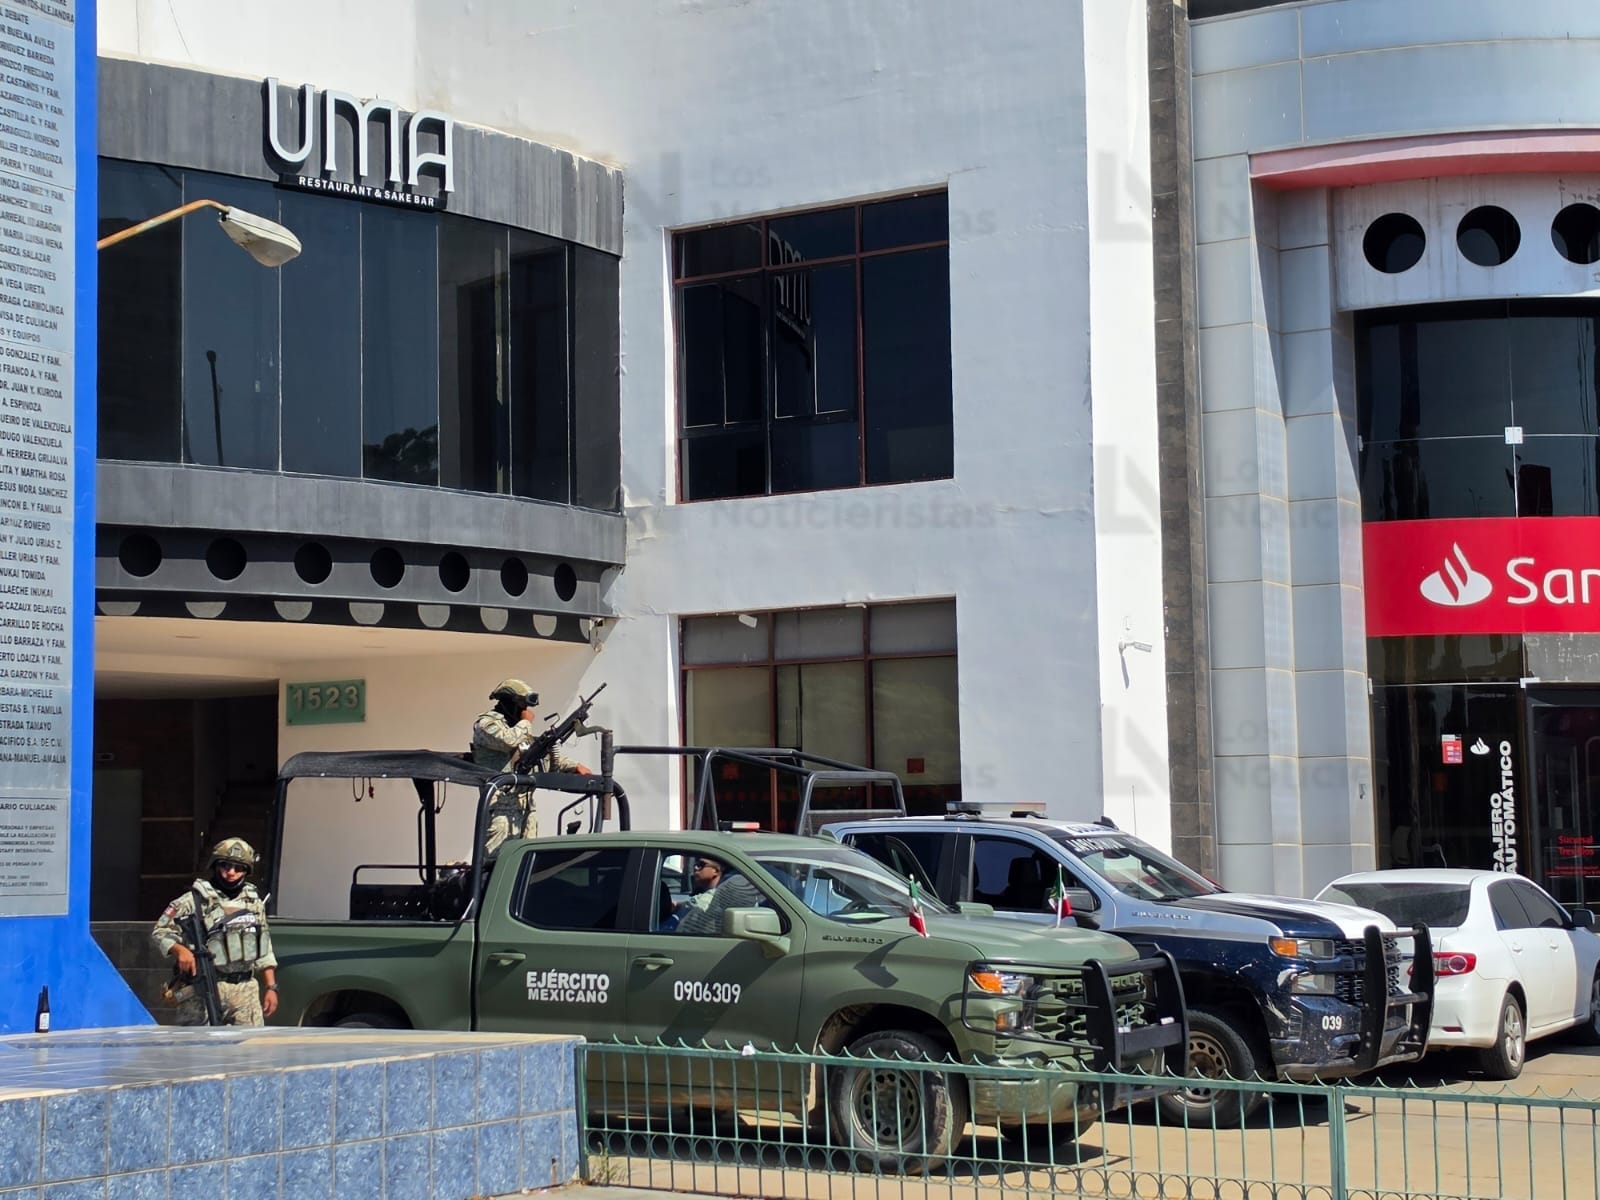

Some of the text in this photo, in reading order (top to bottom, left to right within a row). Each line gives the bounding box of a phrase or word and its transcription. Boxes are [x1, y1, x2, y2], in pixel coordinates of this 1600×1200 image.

[266, 77, 454, 192] UMA
[299, 177, 434, 207] RESTAURANT & SAKE BAR
[22, 433, 62, 448] VALENZUELA
[14, 635, 44, 647] BARRAZA
[295, 686, 358, 711] 1523
[1500, 741, 1517, 874] AUTOMÁTICO
[1491, 793, 1505, 872] CAJERO
[527, 969, 610, 990] EJÉRCITO
[528, 989, 607, 1003] MEXICANO
[674, 981, 741, 1004] 0906309
[1322, 1015, 1342, 1030] 039
